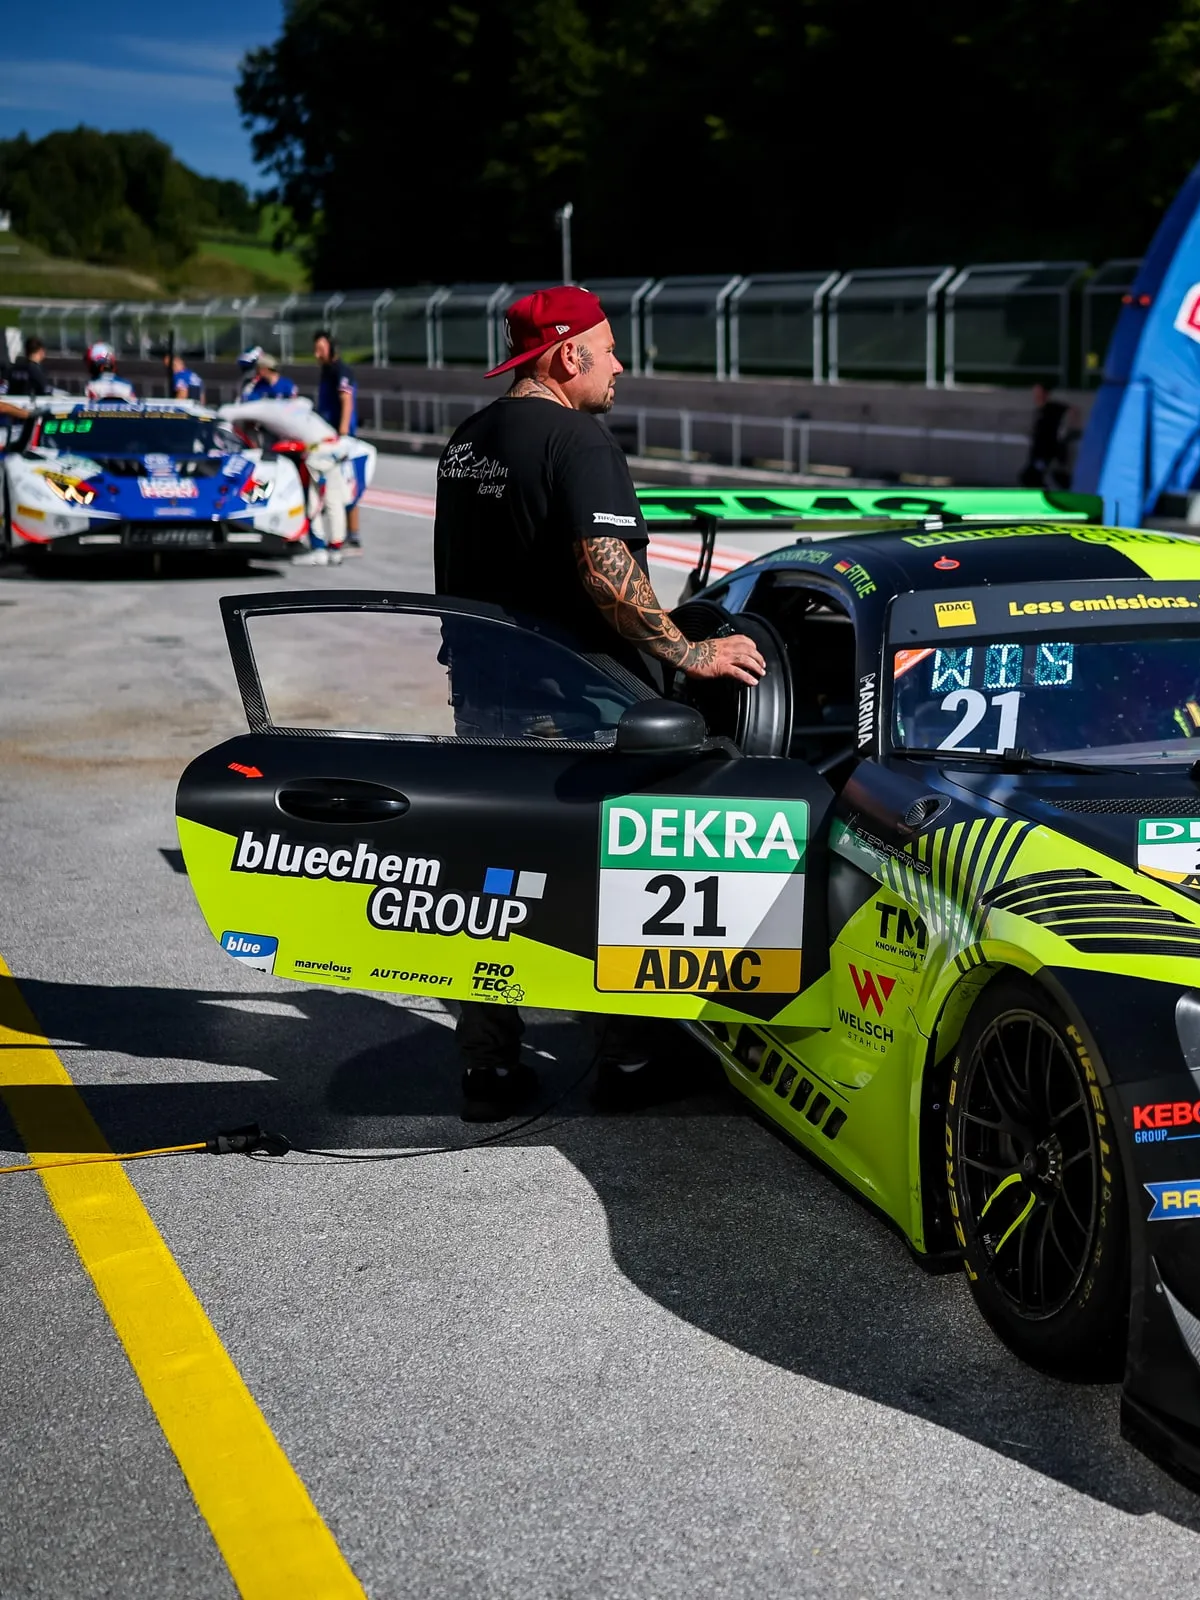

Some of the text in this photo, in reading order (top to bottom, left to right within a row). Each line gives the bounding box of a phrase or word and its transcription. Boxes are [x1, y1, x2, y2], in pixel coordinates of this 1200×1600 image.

[844, 563, 877, 599] FITTJE
[938, 602, 971, 612] ADAC
[1009, 600, 1066, 616] Less
[1070, 594, 1198, 612] emissions.
[931, 642, 1075, 692] WIS
[858, 672, 877, 748] MARINA
[937, 688, 1021, 755] 21
[608, 807, 801, 860] DEKRA
[236, 830, 442, 887] bluechem
[370, 886, 528, 938] GROUP
[641, 873, 727, 937] 21
[226, 937, 261, 954] blue
[875, 940, 897, 953] KNOW
[898, 948, 917, 959] HOW
[295, 959, 352, 974] marvelous
[370, 968, 453, 986] AUTOPROFI
[474, 962, 515, 978] PRO
[633, 949, 762, 992] ADAC
[472, 976, 509, 992] TEC
[837, 1007, 894, 1043] WELSCH
[847, 1031, 887, 1053] STAHLB
[1135, 1130, 1168, 1144] GROUP
